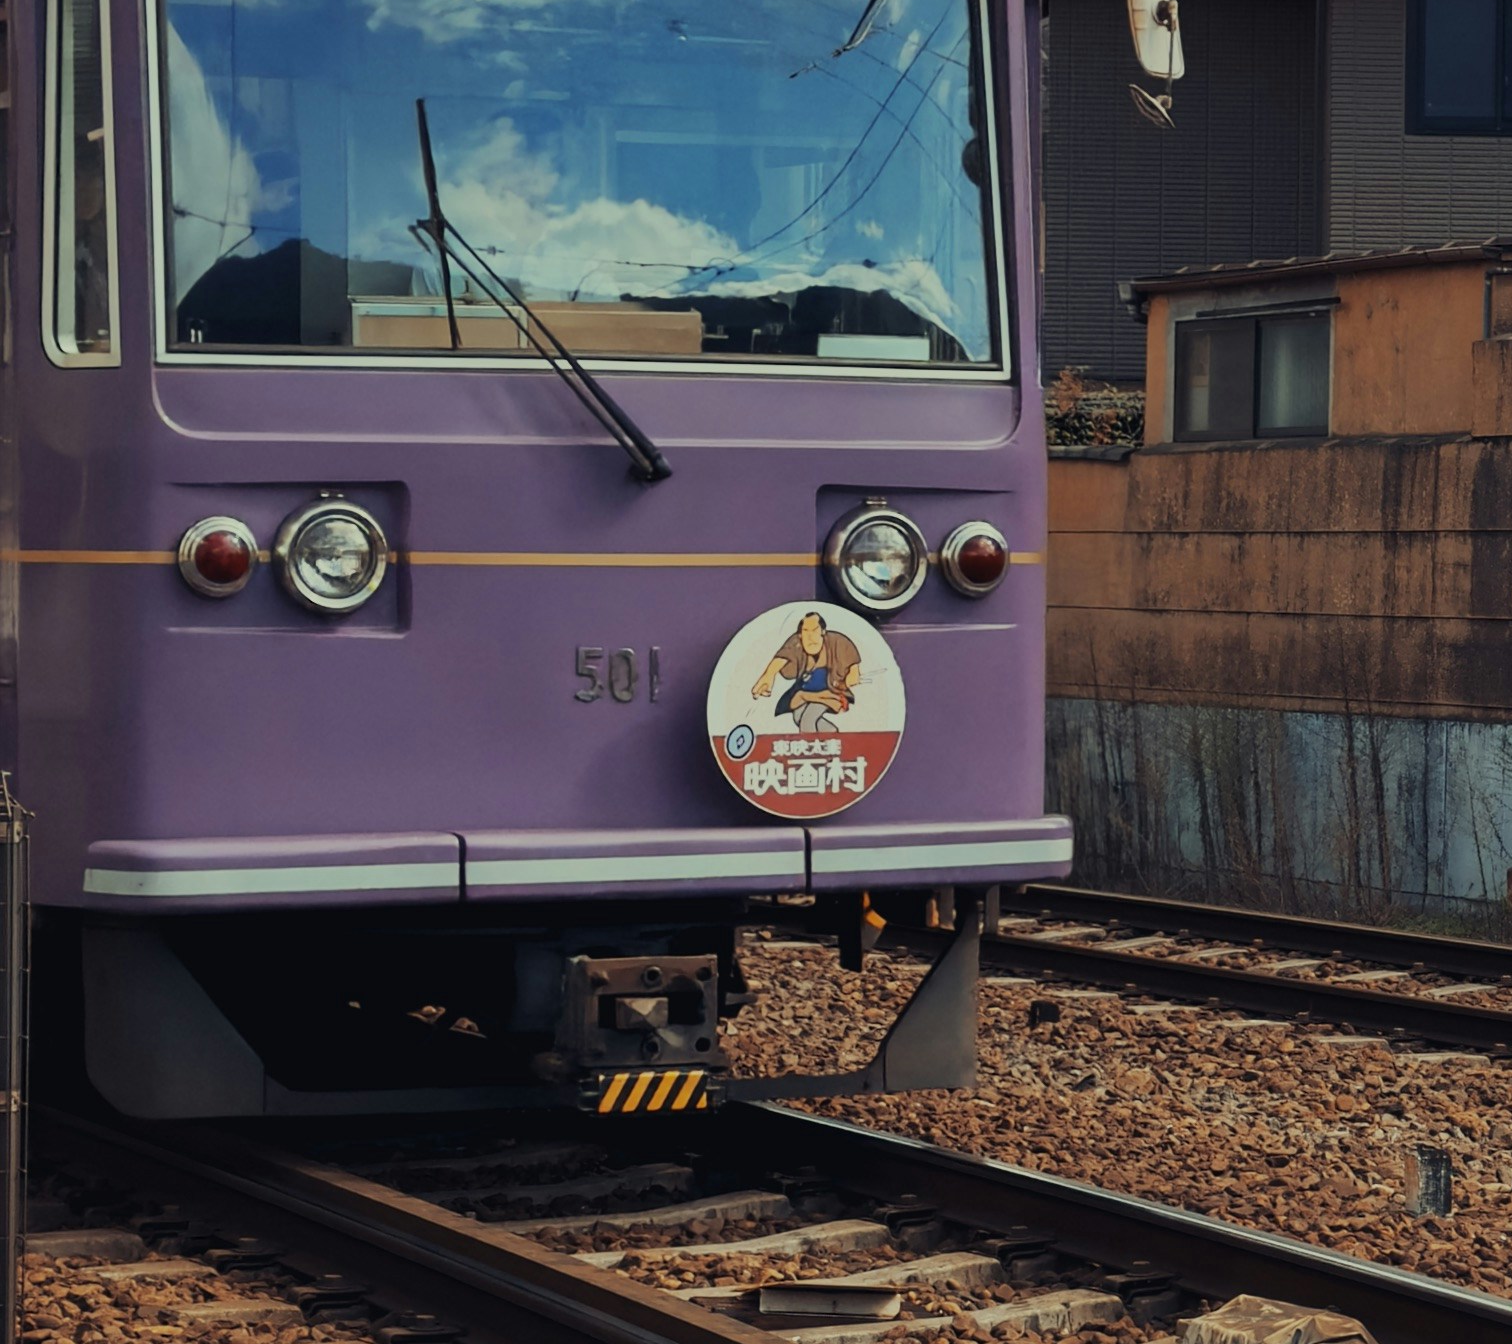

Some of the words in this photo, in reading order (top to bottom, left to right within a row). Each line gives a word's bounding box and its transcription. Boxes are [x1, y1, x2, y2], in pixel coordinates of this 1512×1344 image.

[574, 646, 660, 703] 501
[744, 756, 868, 796] 映画村
